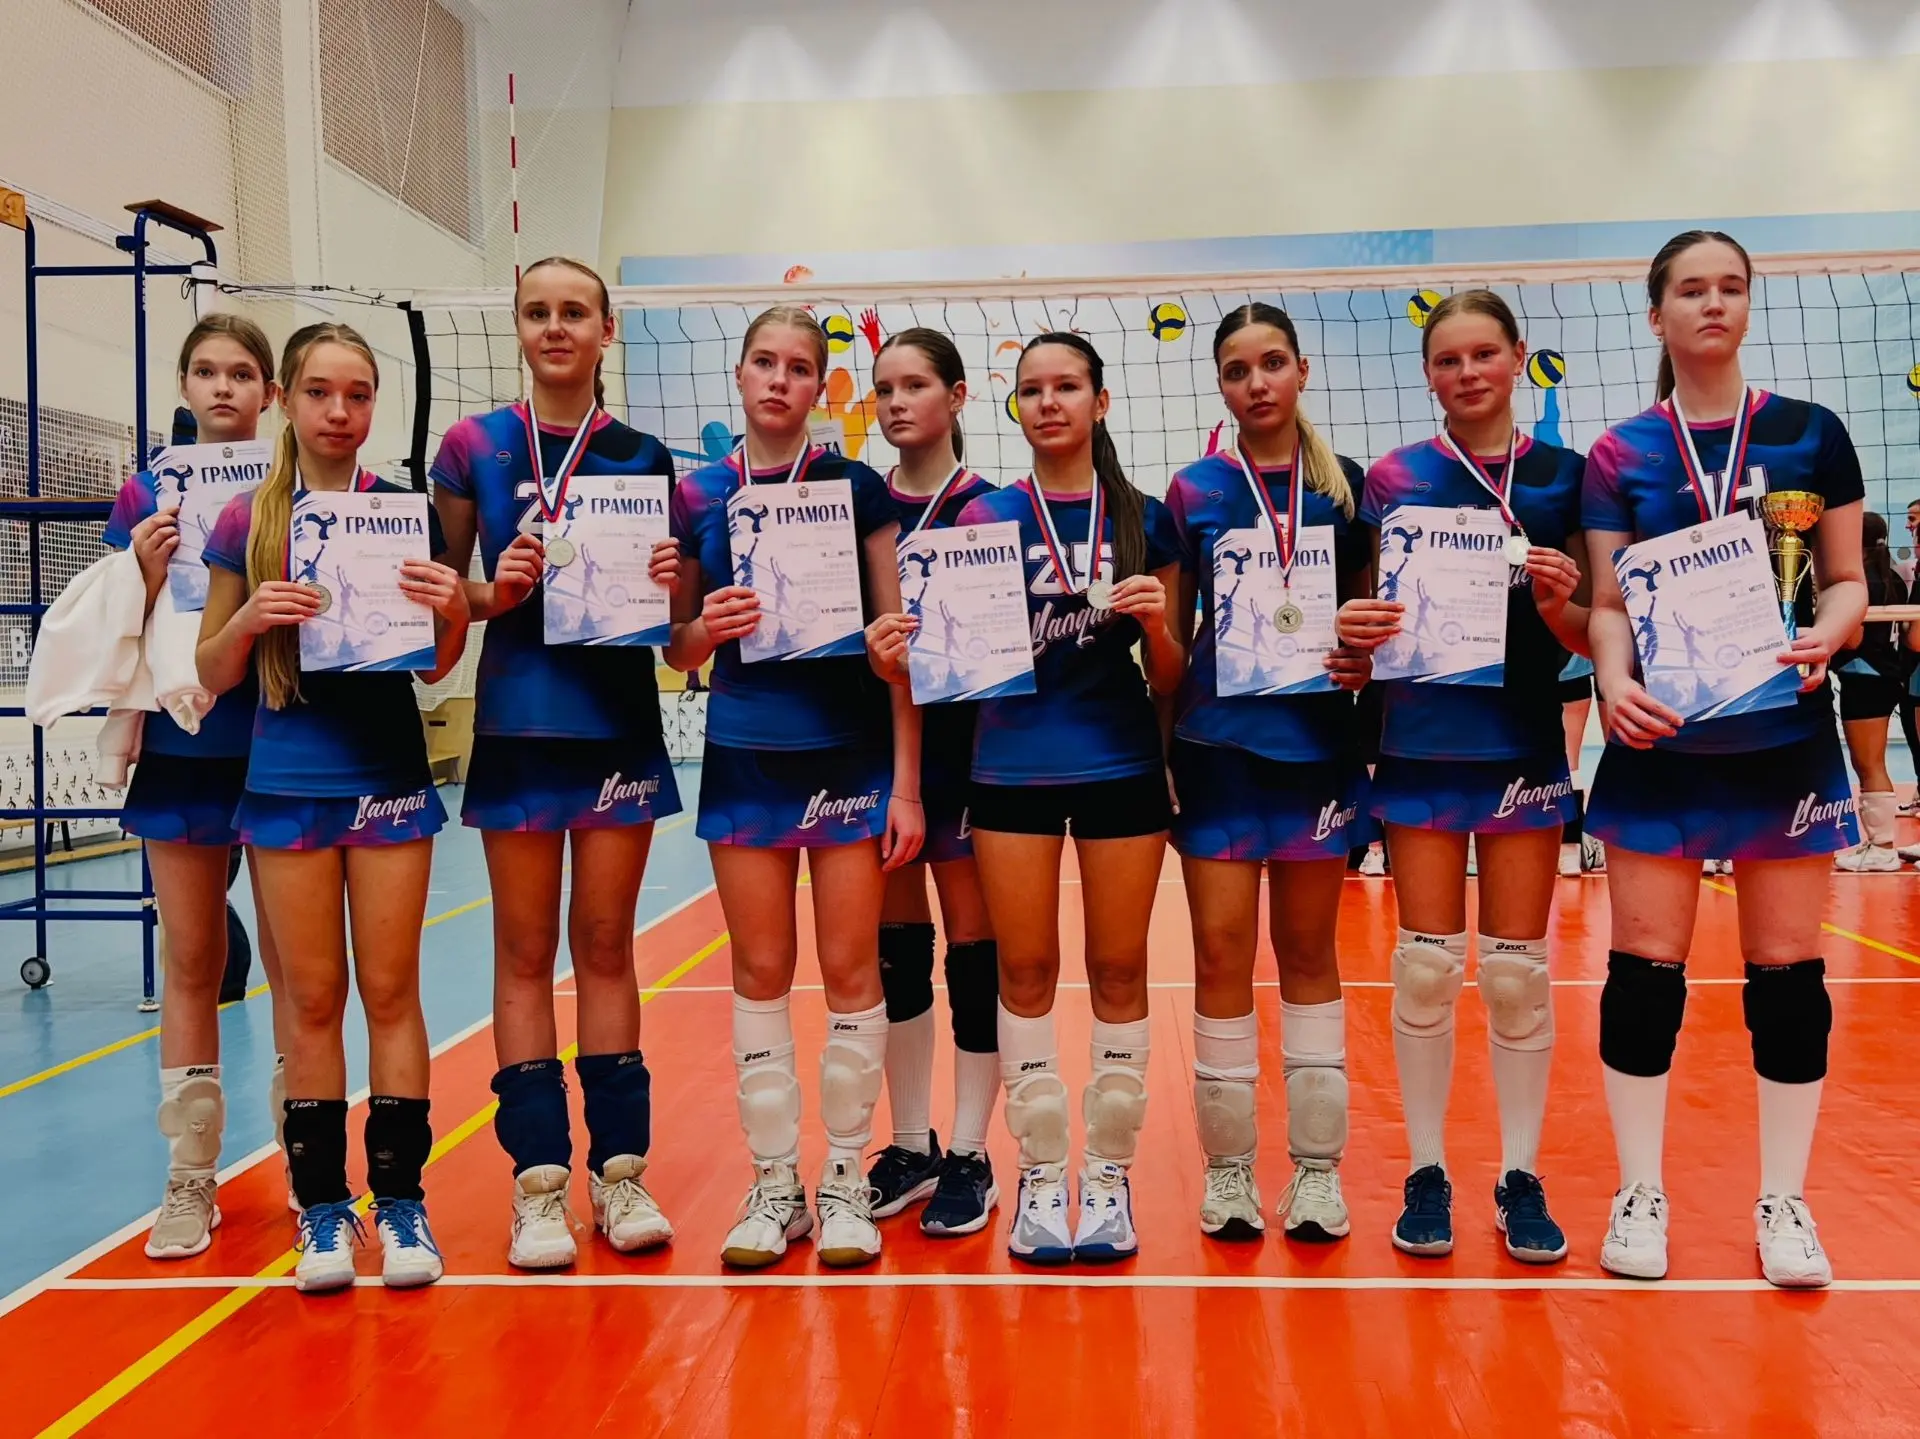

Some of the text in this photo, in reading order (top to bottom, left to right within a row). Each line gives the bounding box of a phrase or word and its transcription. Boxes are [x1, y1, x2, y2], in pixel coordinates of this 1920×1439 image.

[591, 497, 664, 515] ГРАМОТА
[776, 504, 849, 525] ГРАМОТА
[345, 516, 424, 535] ГРАМОТА
[1430, 531, 1504, 551] ГРАМОТА
[944, 545, 1018, 569] ГРАМОТА
[1669, 537, 1754, 577] ГРАМОТА
[348, 789, 427, 831] Валдай
[796, 788, 880, 829] Валдай
[1784, 791, 1854, 837] Валда
